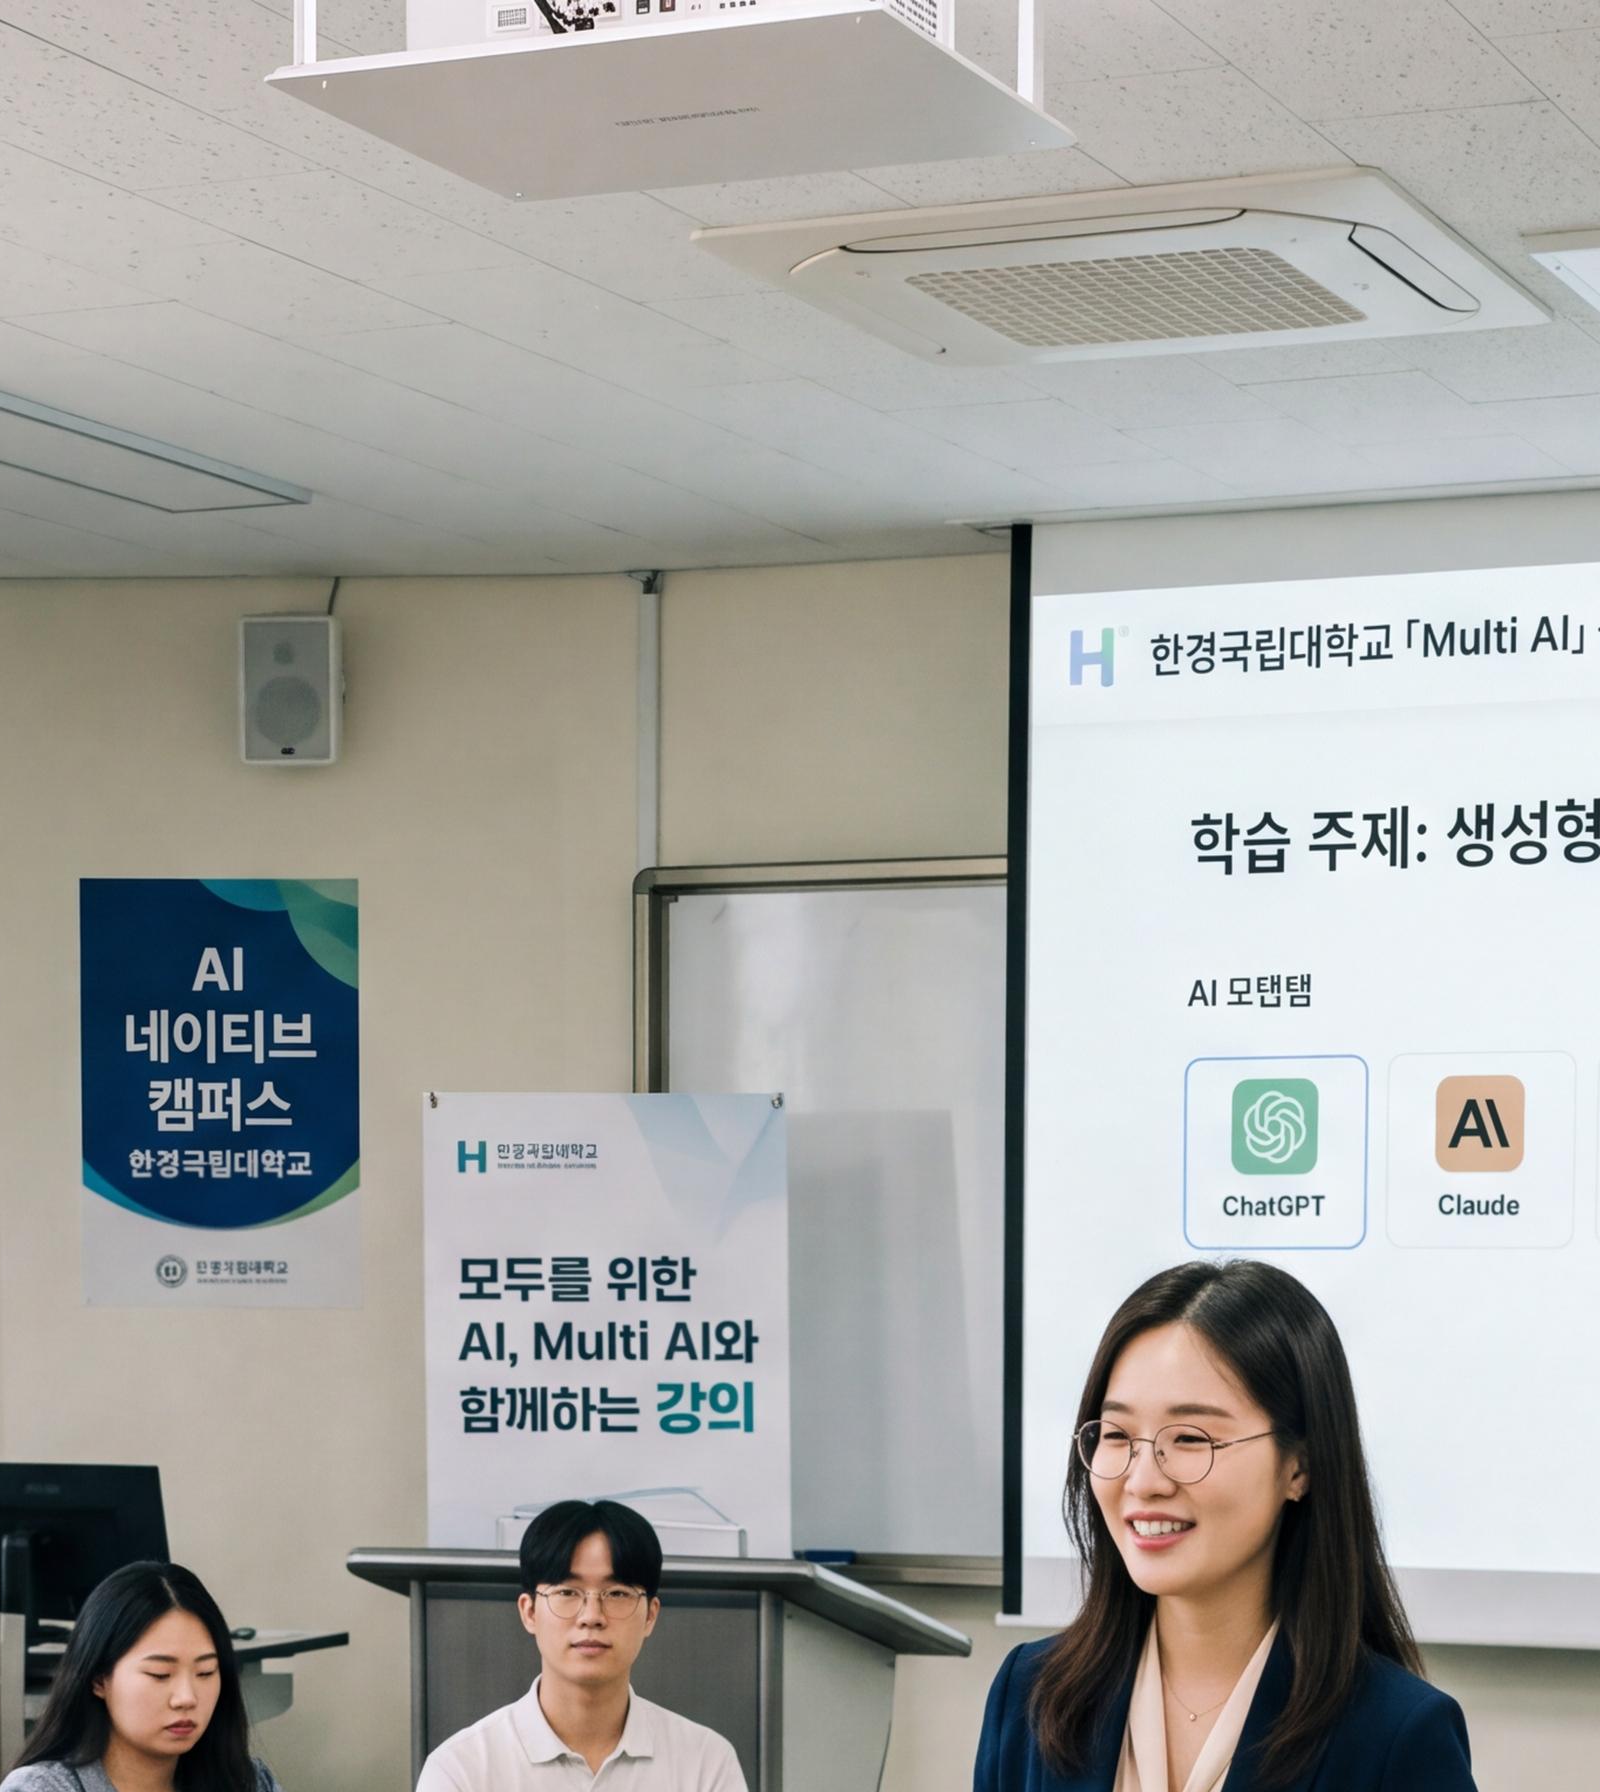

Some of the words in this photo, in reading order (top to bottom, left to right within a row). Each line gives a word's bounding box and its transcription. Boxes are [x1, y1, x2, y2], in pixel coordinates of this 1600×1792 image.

[1150, 622, 1394, 677] 한경국립대학교
[1190, 811, 1291, 876] 학습
[1308, 805, 1427, 872] 주제:
[191, 946, 244, 992] AI
[1187, 979, 1217, 1007] AI
[125, 1009, 318, 1065] 네이티브
[148, 1077, 293, 1132] 캠퍼스
[1222, 1195, 1326, 1217] ChatGPT
[1438, 1193, 1520, 1216] Claude
[458, 1256, 592, 1303] 모두를
[607, 1255, 698, 1303] 위한
[458, 1321, 518, 1368] AI,
[533, 1319, 649, 1361] Multi
[664, 1319, 760, 1364] AI와
[459, 1385, 641, 1434] 함께하는
[656, 1381, 754, 1435] 강의
